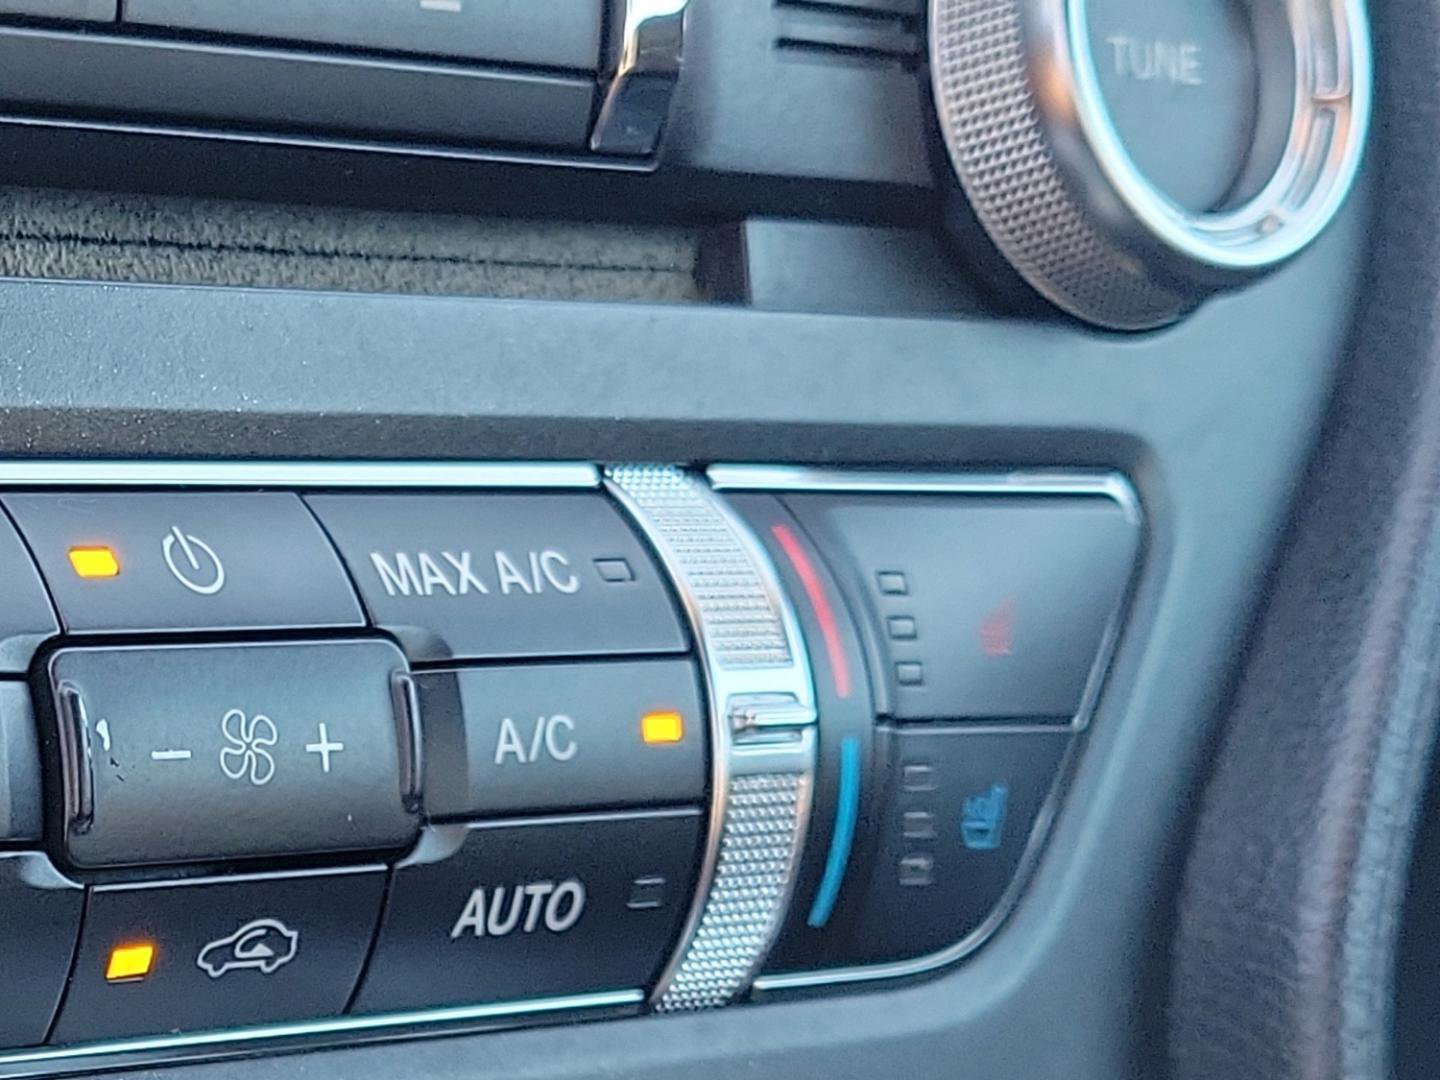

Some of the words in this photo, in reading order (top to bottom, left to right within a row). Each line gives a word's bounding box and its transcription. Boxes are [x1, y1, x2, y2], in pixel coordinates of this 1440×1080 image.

[1106, 35, 1203, 86] TUNE
[370, 551, 489, 596] MAX
[494, 549, 580, 595] A/C
[493, 714, 578, 765] A/C
[451, 878, 585, 940] AUTO
